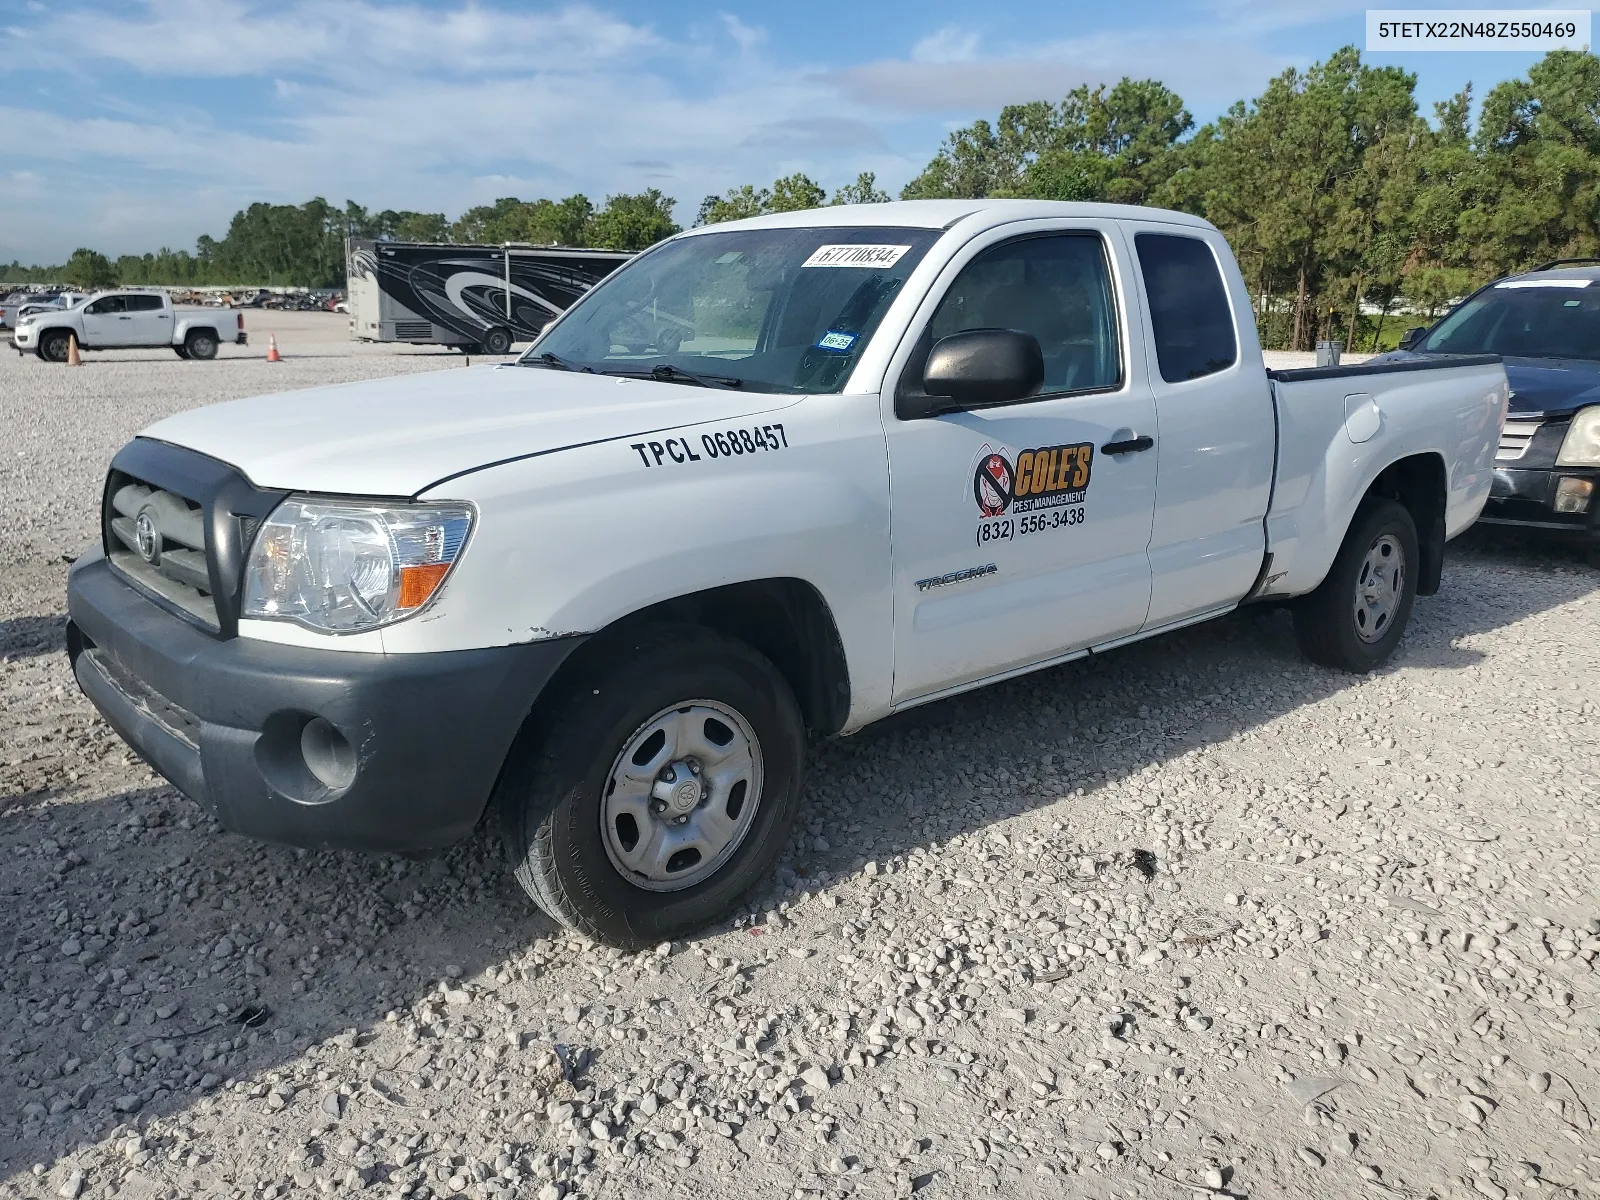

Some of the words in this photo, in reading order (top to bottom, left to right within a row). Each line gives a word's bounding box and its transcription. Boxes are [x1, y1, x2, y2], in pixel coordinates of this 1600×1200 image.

[630, 437, 702, 468] TPCL
[701, 423, 789, 459] 0688457
[1014, 445, 1092, 497] COLE'S
[1013, 500, 1034, 513] PEST
[1034, 491, 1086, 509] MANAGEMENT
[976, 519, 1015, 547] (832)
[1020, 507, 1085, 535] 556-3438
[914, 562, 998, 592] TACOMA
